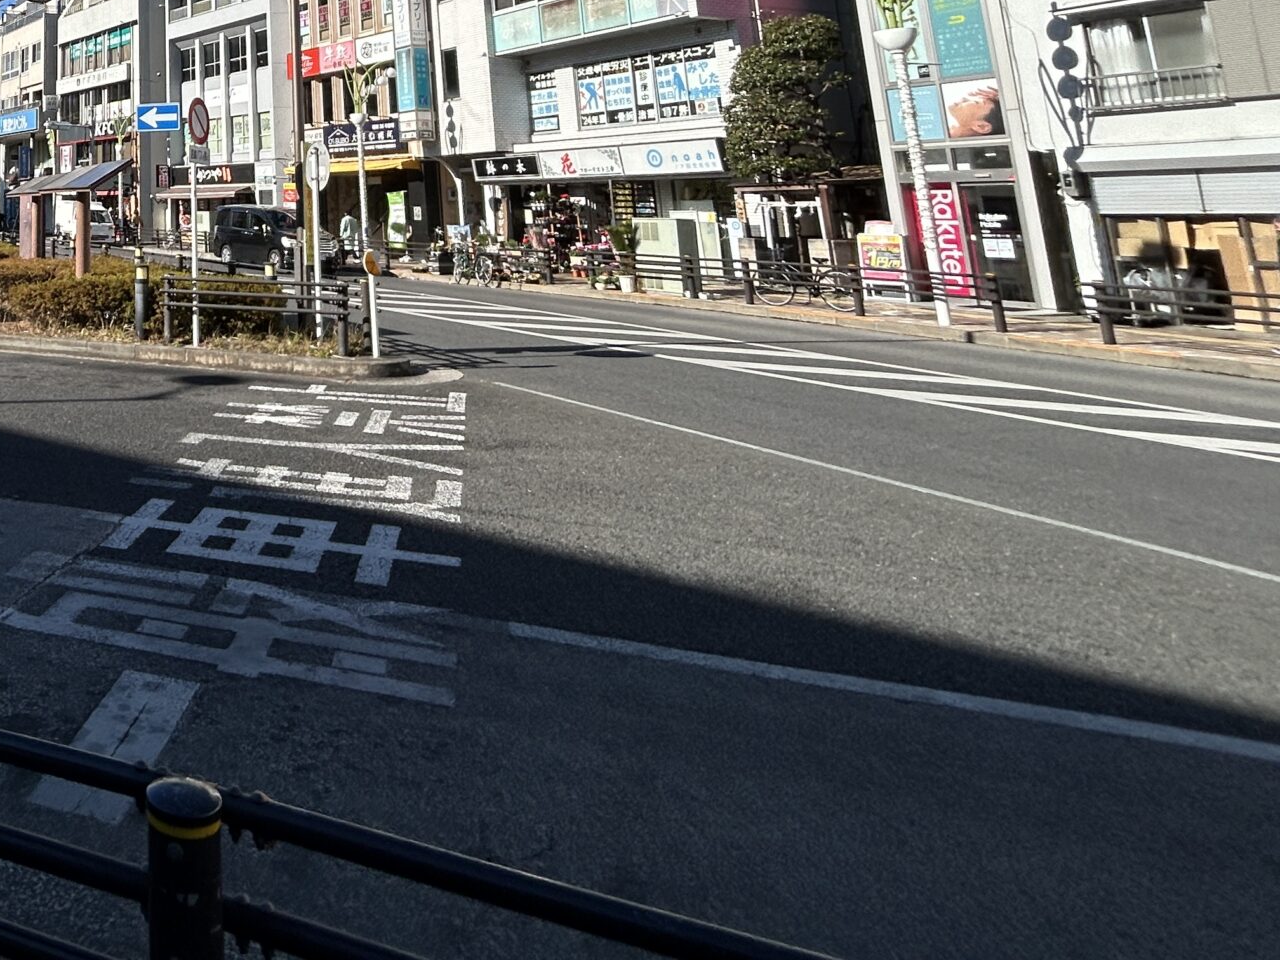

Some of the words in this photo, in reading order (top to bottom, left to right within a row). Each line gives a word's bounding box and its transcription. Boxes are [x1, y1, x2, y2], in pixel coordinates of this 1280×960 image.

[687, 61, 708, 74] みや
[698, 72, 719, 84] した
[94, 121, 115, 137] KFC
[671, 149, 716, 163] noah
[560, 153, 577, 175] 花
[196, 168, 222, 183] かつや
[930, 189, 967, 291] Rakuten
